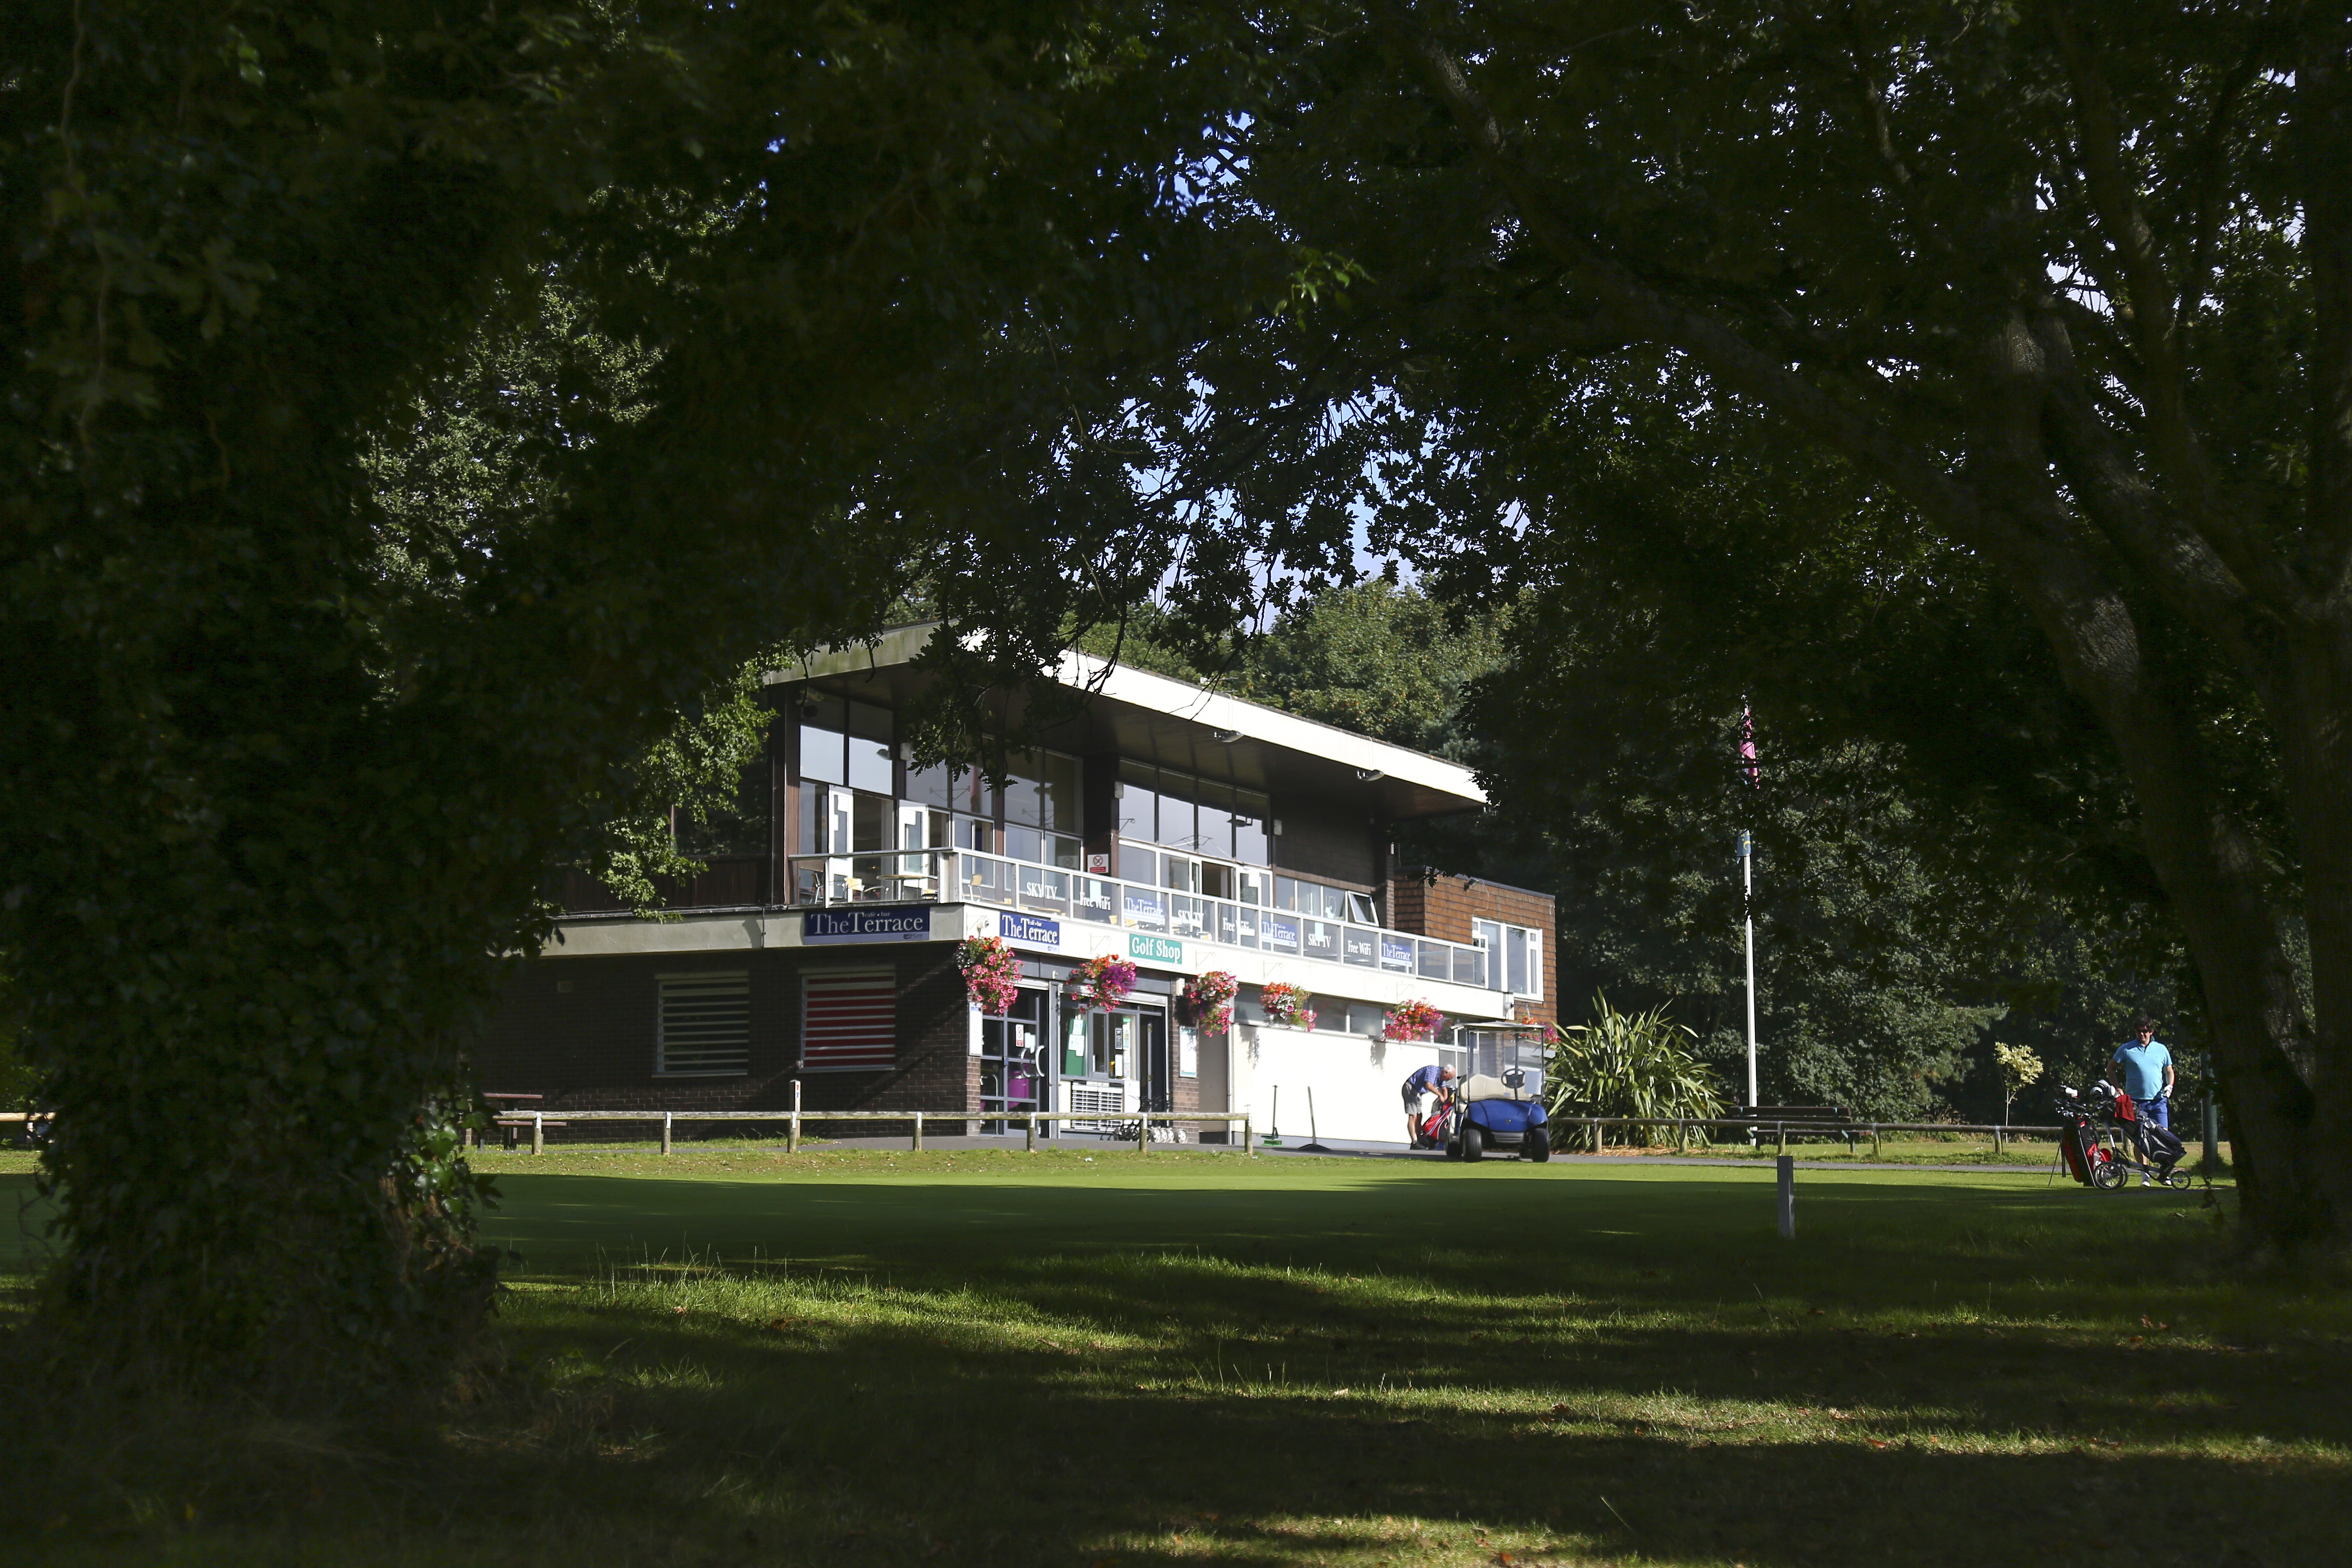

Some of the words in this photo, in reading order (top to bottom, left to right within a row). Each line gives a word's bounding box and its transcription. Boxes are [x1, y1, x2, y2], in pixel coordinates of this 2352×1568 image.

[1026, 882, 1043, 898] SKY
[1045, 885, 1058, 900] TV
[1080, 892, 1094, 907] Free
[1094, 895, 1111, 910] WiFi
[1223, 918, 1235, 932] Free
[1132, 937, 1154, 956] Golf
[1156, 940, 1180, 964] Shop
[1323, 936, 1331, 948] TV
[1348, 940, 1359, 954] Free
[1359, 942, 1371, 956] WiFi
